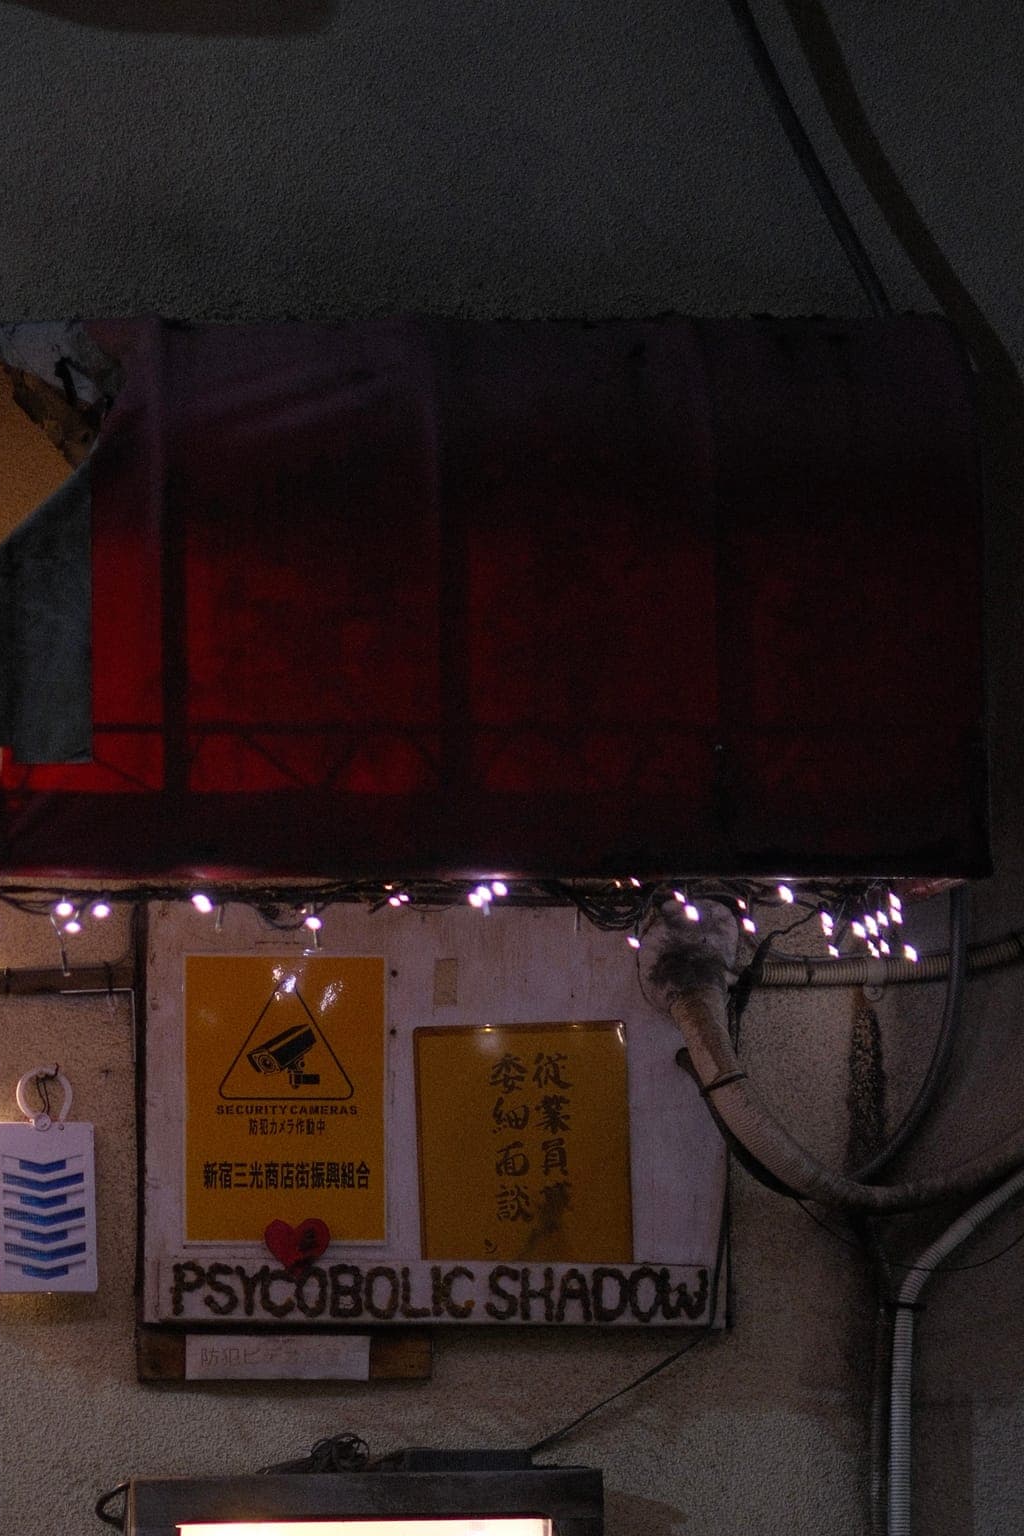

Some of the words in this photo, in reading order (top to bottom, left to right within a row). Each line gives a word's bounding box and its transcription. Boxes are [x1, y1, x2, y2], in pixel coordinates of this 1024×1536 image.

[216, 1105, 287, 1115] SECURITY
[290, 1105, 358, 1115] CAMERAS
[249, 1119, 326, 1136] 防犯カメラ作動中
[489, 1052, 533, 1223] 委細面談
[203, 1161, 370, 1189] 新宿三光商店街振興組合
[172, 1262, 475, 1319] PSYCOBOLIC
[485, 1264, 711, 1322] SHADOW
